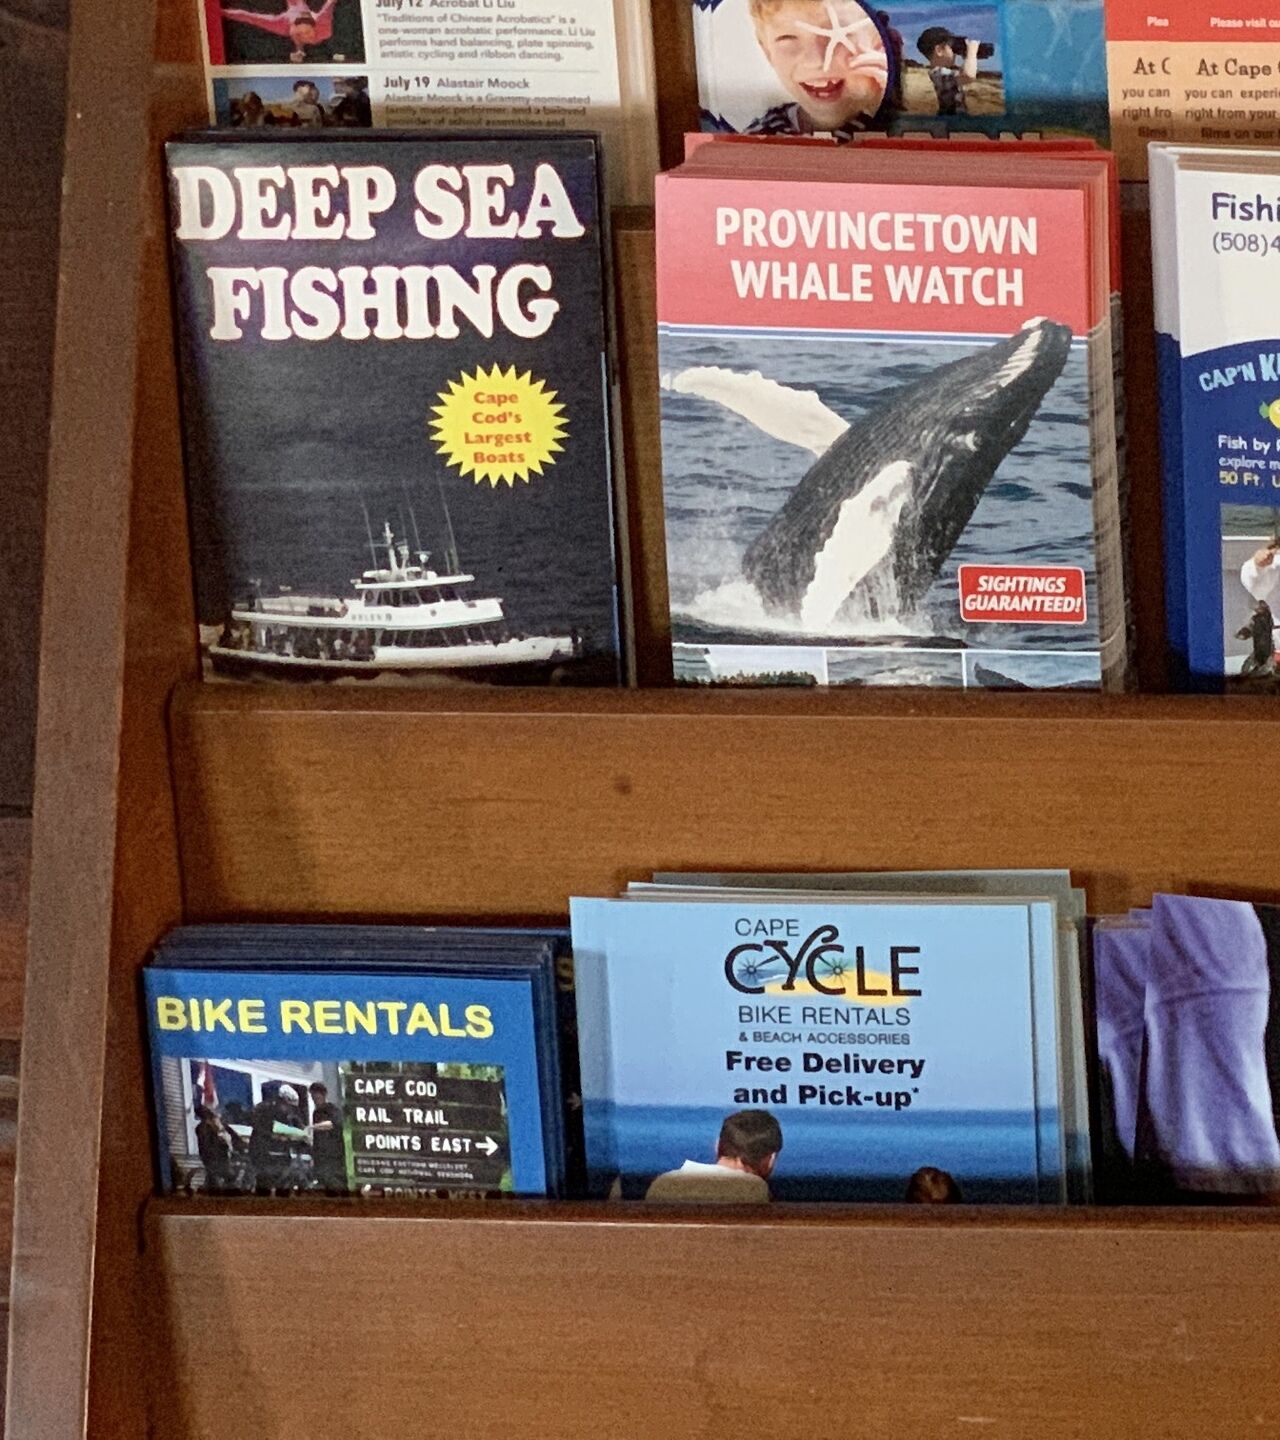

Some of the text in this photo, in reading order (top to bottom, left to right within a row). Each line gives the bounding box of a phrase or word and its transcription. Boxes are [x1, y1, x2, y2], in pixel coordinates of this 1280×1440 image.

[174, 164, 586, 241] DEEP SEA
[716, 207, 1037, 255] PROVINCETOWN
[730, 260, 1024, 307] WHALE WATCH
[208, 265, 561, 341] FISHING
[473, 392, 518, 407] Cape
[472, 411, 522, 425] Cod's
[464, 431, 532, 448] Largest
[473, 451, 526, 465] Boats
[977, 576, 1066, 593] SIGHTINGS
[964, 594, 1081, 614] GUARANTEED!
[735, 918, 800, 937] CAPE
[724, 924, 922, 997] CYCLE
[156, 996, 495, 1039] BIKE RENTALS
[726, 1051, 925, 1079] Free Delivery
[355, 1079, 437, 1097] CAPE COD
